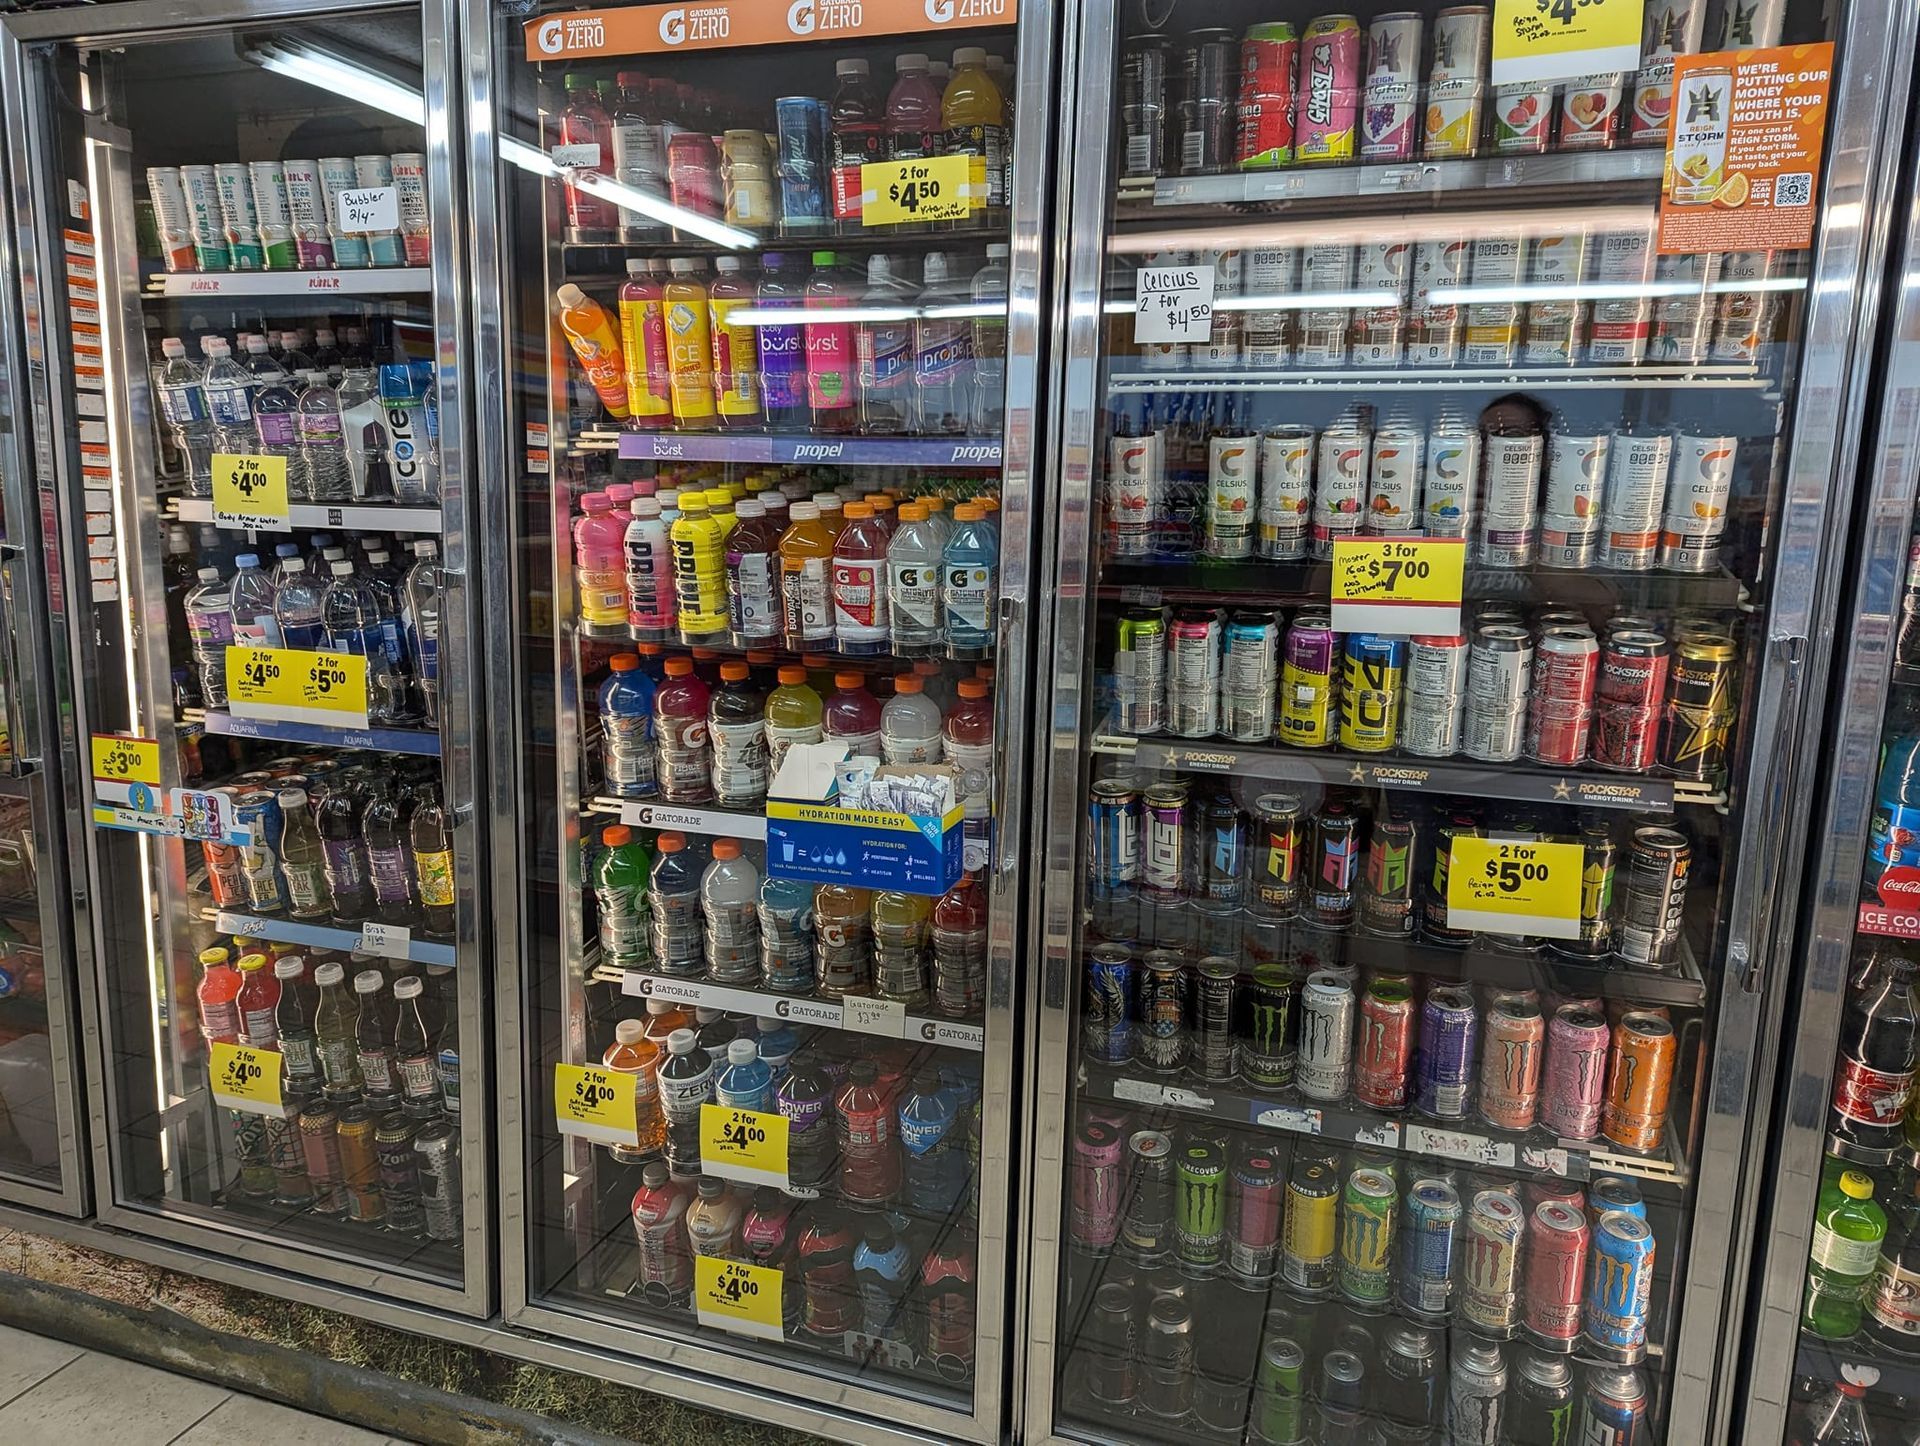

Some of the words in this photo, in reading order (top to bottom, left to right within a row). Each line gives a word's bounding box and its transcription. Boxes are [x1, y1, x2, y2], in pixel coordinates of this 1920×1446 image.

[690, 7, 728, 17] GATORADE
[820, 4, 862, 30] ZERO
[567, 18, 602, 27] GATORADE
[1513, 16, 1538, 26] Reign
[690, 16, 730, 40] ZERO
[1516, 23, 1544, 37] Storm
[567, 27, 604, 49] ZERO
[1737, 63, 1779, 75] WE'RE
[1736, 72, 1795, 88] PUTTING
[1798, 70, 1828, 82] OUR
[1306, 60, 1335, 126] GHOST
[1735, 86, 1784, 99] MONEY
[1734, 98, 1780, 110] WHERE
[1784, 95, 1822, 107] YOUR
[1732, 109, 1783, 122] MOUTH
[1786, 108, 1802, 119] IS.
[1689, 125, 1714, 133] REIGN
[1732, 129, 1746, 137] Try
[1678, 132, 1724, 143] STORM
[1731, 136, 1760, 145] REIGN
[1762, 133, 1800, 143] STORM.
[1738, 146, 1754, 154] you
[1756, 143, 1779, 151] don't
[1771, 152, 1785, 160] get
[1787, 151, 1808, 159] your
[1728, 162, 1756, 170] money
[1758, 160, 1781, 168] back.
[911, 167, 929, 178] for
[343, 192, 384, 206] Bubbler
[1143, 271, 1198, 291] Celcius
[1140, 297, 1149, 312] 2
[1159, 294, 1181, 308] for
[390, 408, 416, 478] core
[794, 443, 843, 459] propel
[247, 460, 259, 470] for
[1216, 480, 1247, 488] CELSIUS
[1332, 481, 1364, 490] CELSIUS
[1372, 481, 1402, 490] CELSIUS
[1430, 482, 1464, 491] CELSIUS
[1383, 544, 1391, 556] 3
[1396, 544, 1418, 557] for
[260, 652, 272, 661] for
[326, 657, 338, 667] for
[229, 723, 259, 735] AQUAFINA
[123, 742, 134, 751] for
[343, 735, 374, 747] AQUAFINA
[1185, 752, 1236, 764] ROCKSTAR
[1372, 767, 1429, 780] ROCKSTAR
[1578, 783, 1641, 797] ROCKSTAR
[1584, 794, 1611, 802] ENERGY
[655, 814, 702, 826] GATORADE
[800, 809, 850, 821] HYDRATION
[854, 812, 879, 824] MADE
[882, 816, 905, 827] EASY
[1500, 845, 1508, 857] 2
[1514, 846, 1536, 859] for
[1468, 878, 1493, 888] Reign
[1860, 911, 1888, 924] ICE
[365, 924, 386, 934] Brisk
[655, 985, 700, 998] GATORADE
[792, 1006, 840, 1021] GATORADE
[244, 1052, 255, 1062] for
[593, 1073, 606, 1083] for
[779, 1098, 822, 1114] POWER
[742, 1113, 756, 1125] for
[1185, 1164, 1218, 1175] RECOVER
[735, 1266, 750, 1278] for
